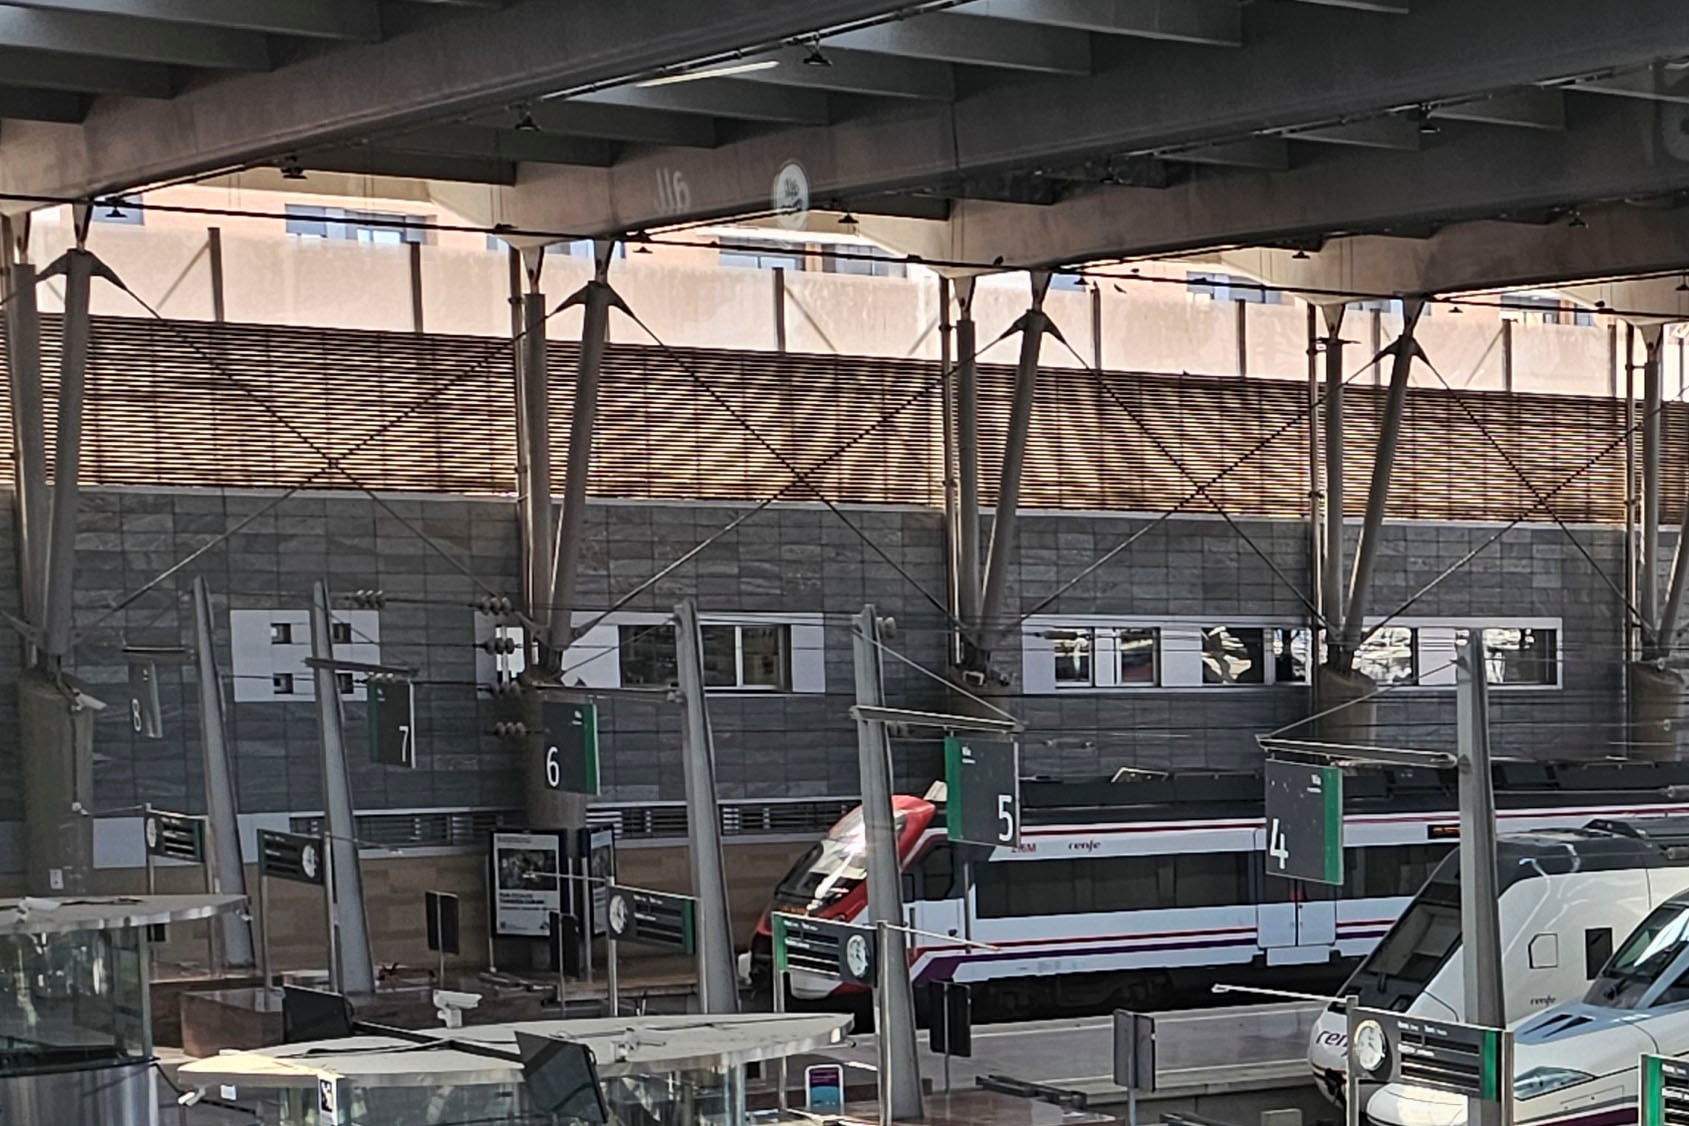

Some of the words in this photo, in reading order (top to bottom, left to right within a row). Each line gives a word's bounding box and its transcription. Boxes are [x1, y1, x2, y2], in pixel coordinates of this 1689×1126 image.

[131, 698, 142, 732] 8
[399, 725, 409, 763] 7
[546, 746, 561, 788] 6
[997, 794, 1014, 842] 5
[1067, 840, 1101, 853] renfe
[1269, 817, 1290, 870] 4
